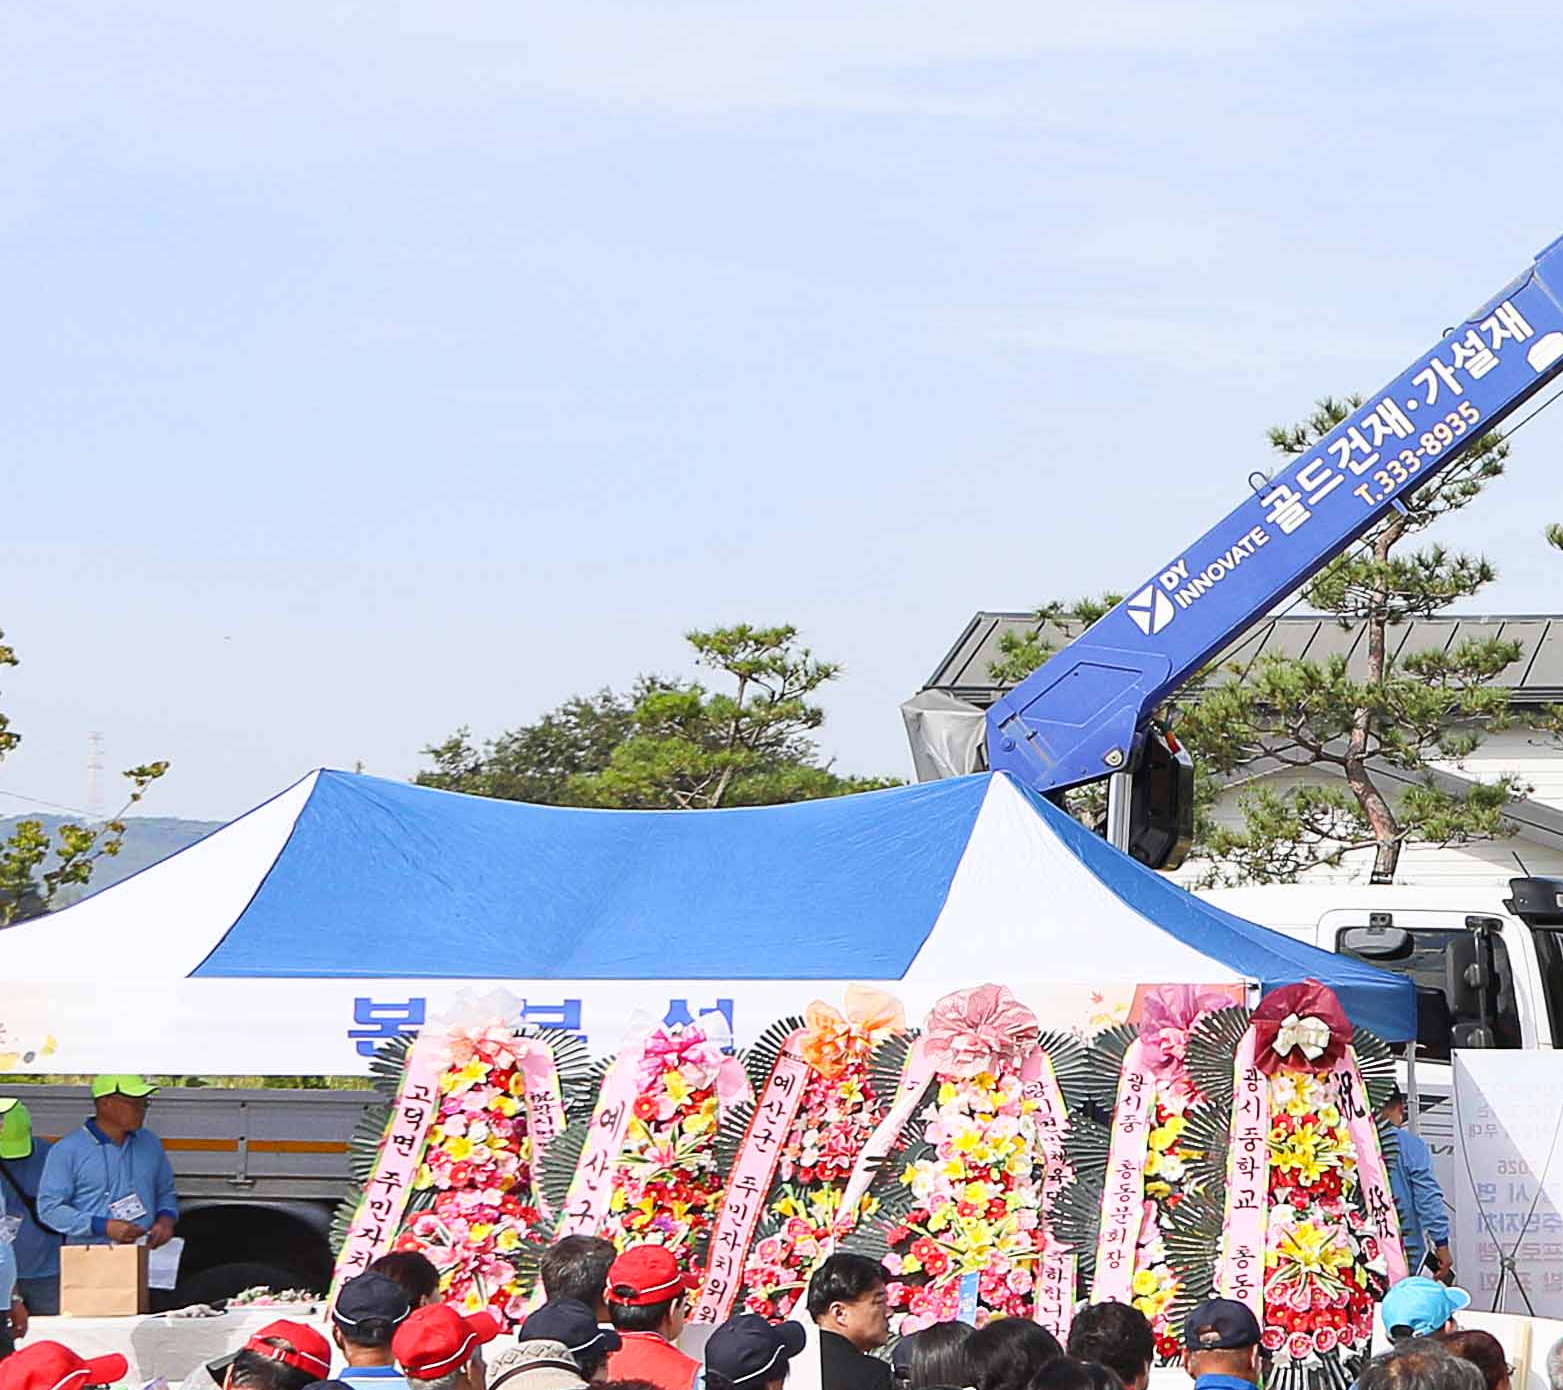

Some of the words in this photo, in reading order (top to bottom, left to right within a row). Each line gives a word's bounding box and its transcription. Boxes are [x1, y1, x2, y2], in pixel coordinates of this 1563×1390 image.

[1353, 400, 1481, 508] T.333-8935
[1160, 559, 1189, 592] DY
[1173, 525, 1270, 609] INNOVATE
[391, 1084, 433, 1158] 고덕면
[754, 1074, 796, 1153] 예산군
[1117, 1072, 1149, 1133] 광시중
[1233, 1068, 1265, 1210] 광시중학교
[569, 1101, 626, 1236] 예산군
[342, 1171, 403, 1279] 주민자치
